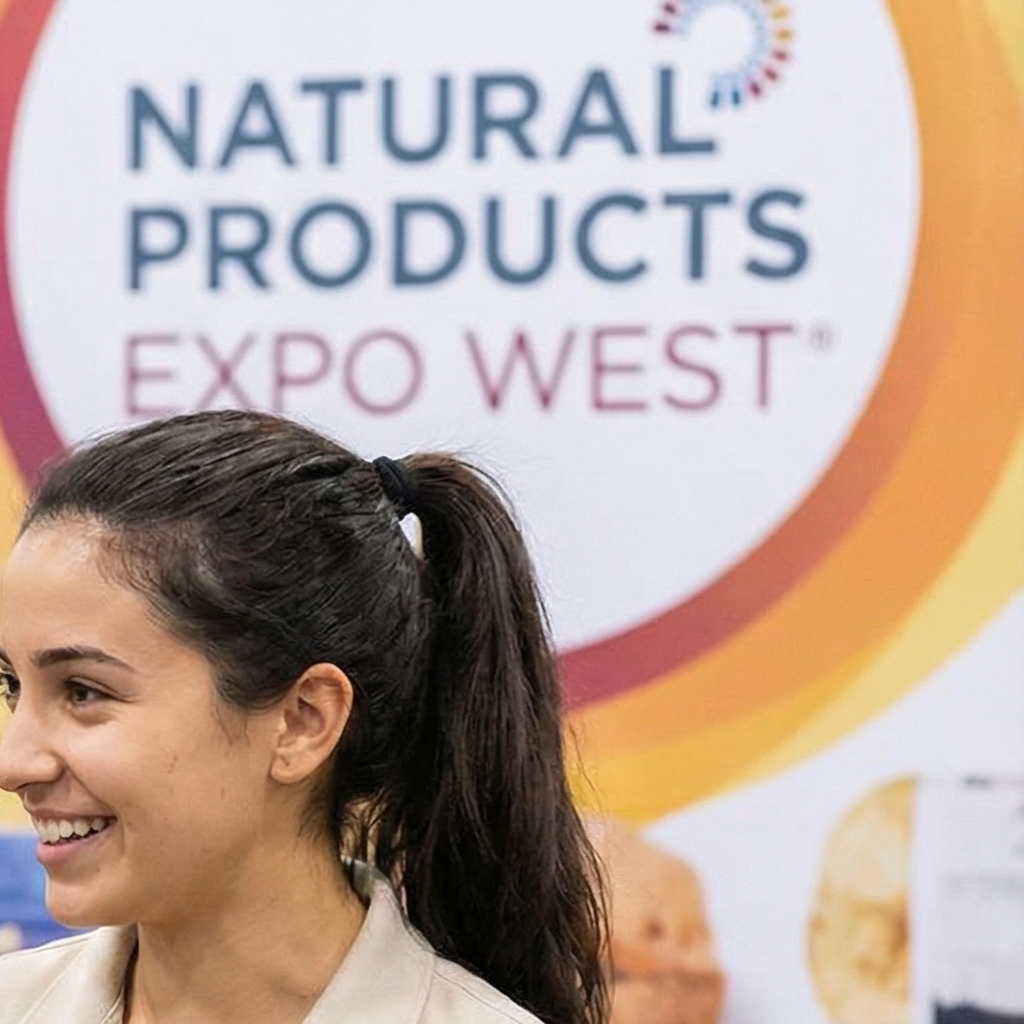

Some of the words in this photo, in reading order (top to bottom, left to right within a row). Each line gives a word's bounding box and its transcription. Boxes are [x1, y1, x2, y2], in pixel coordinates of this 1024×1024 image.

[126, 65, 718, 171] NATURAL
[126, 189, 809, 292] PRODUCTS
[125, 329, 423, 415] EXPO
